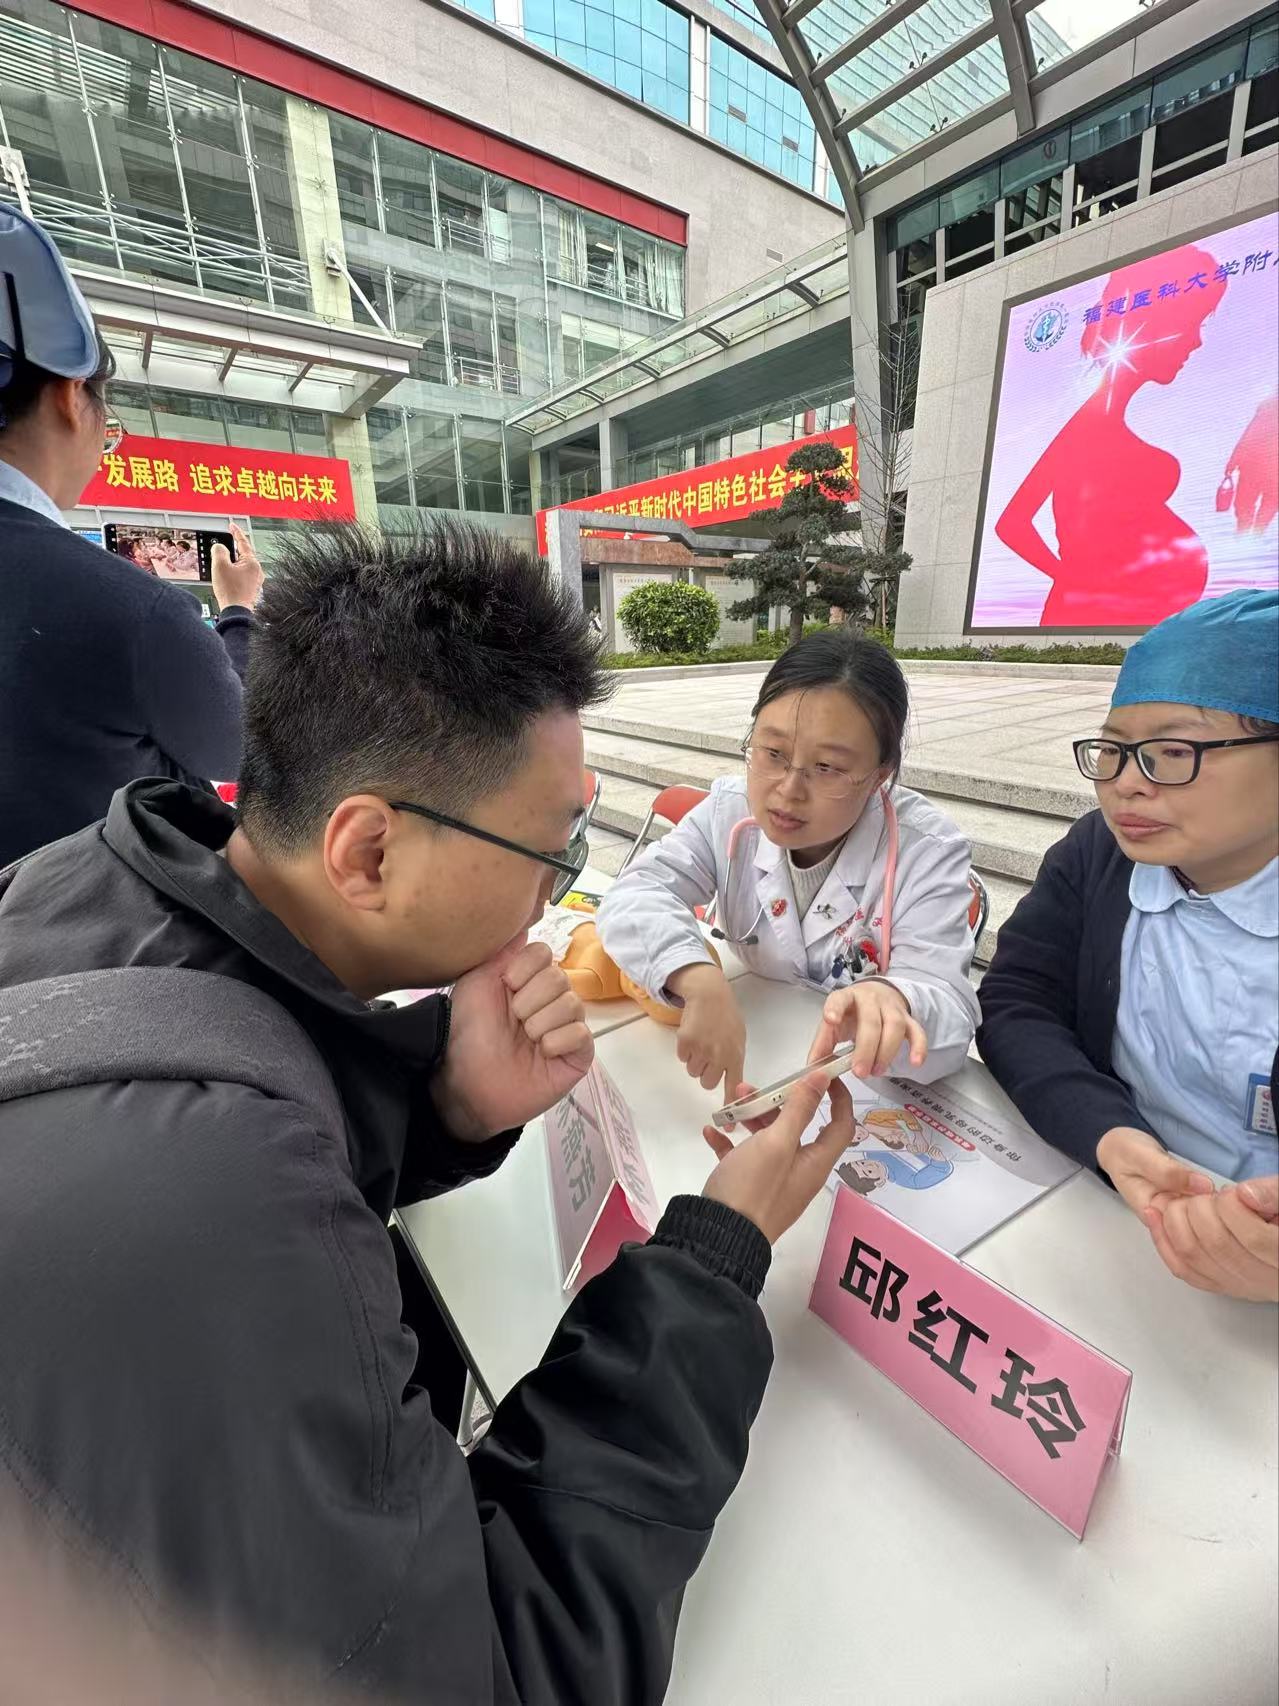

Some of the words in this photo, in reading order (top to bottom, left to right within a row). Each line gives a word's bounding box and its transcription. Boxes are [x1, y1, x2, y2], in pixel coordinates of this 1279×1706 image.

[1082, 249, 1279, 326] 福建医科大学附
[97, 454, 180, 493] 发展路
[189, 463, 338, 505] 追求卓越向未来
[839, 1236, 1087, 1460] 邱红玲
